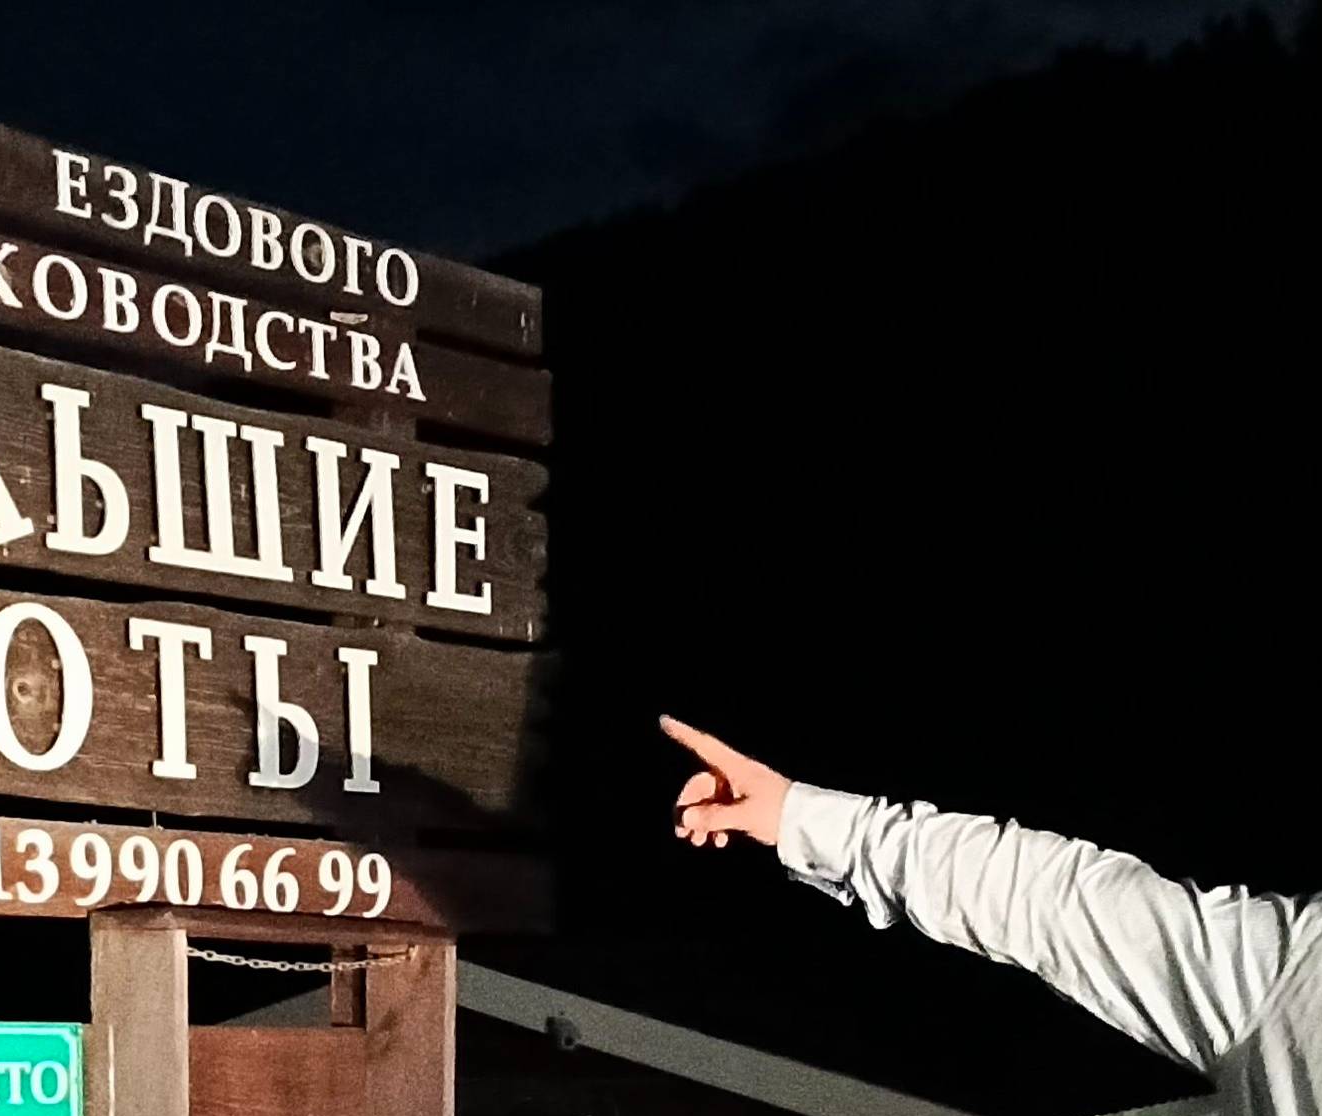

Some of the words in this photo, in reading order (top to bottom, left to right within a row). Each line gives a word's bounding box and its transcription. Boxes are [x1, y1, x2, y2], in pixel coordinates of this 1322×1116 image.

[51, 148, 420, 308] ЕЗДОВОГО
[219, 842, 301, 913] 66
[318, 849, 393, 920] 99
